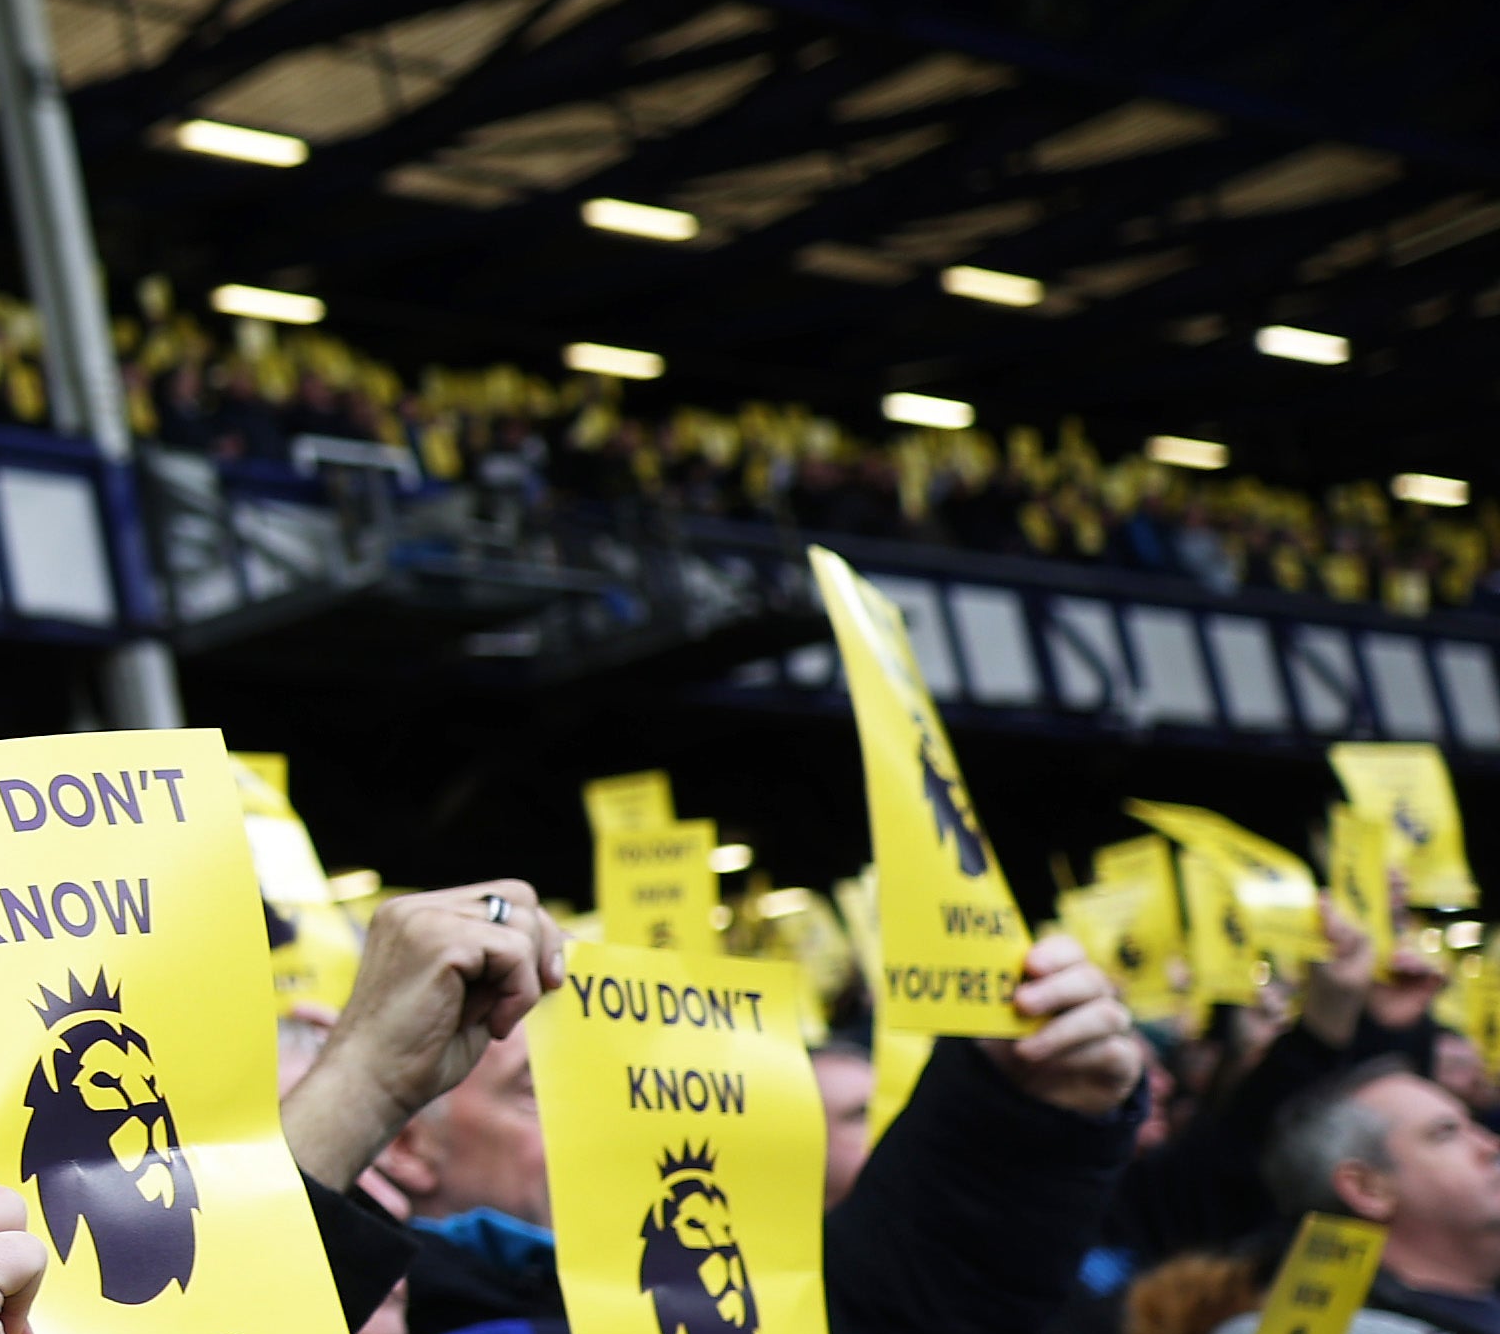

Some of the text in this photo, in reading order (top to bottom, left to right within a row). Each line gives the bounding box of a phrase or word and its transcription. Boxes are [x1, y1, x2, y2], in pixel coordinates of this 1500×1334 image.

[568, 974, 763, 1033] YOU DON'T
[885, 964, 990, 1003] YOU'RE
[627, 1065, 745, 1114] KNOW
